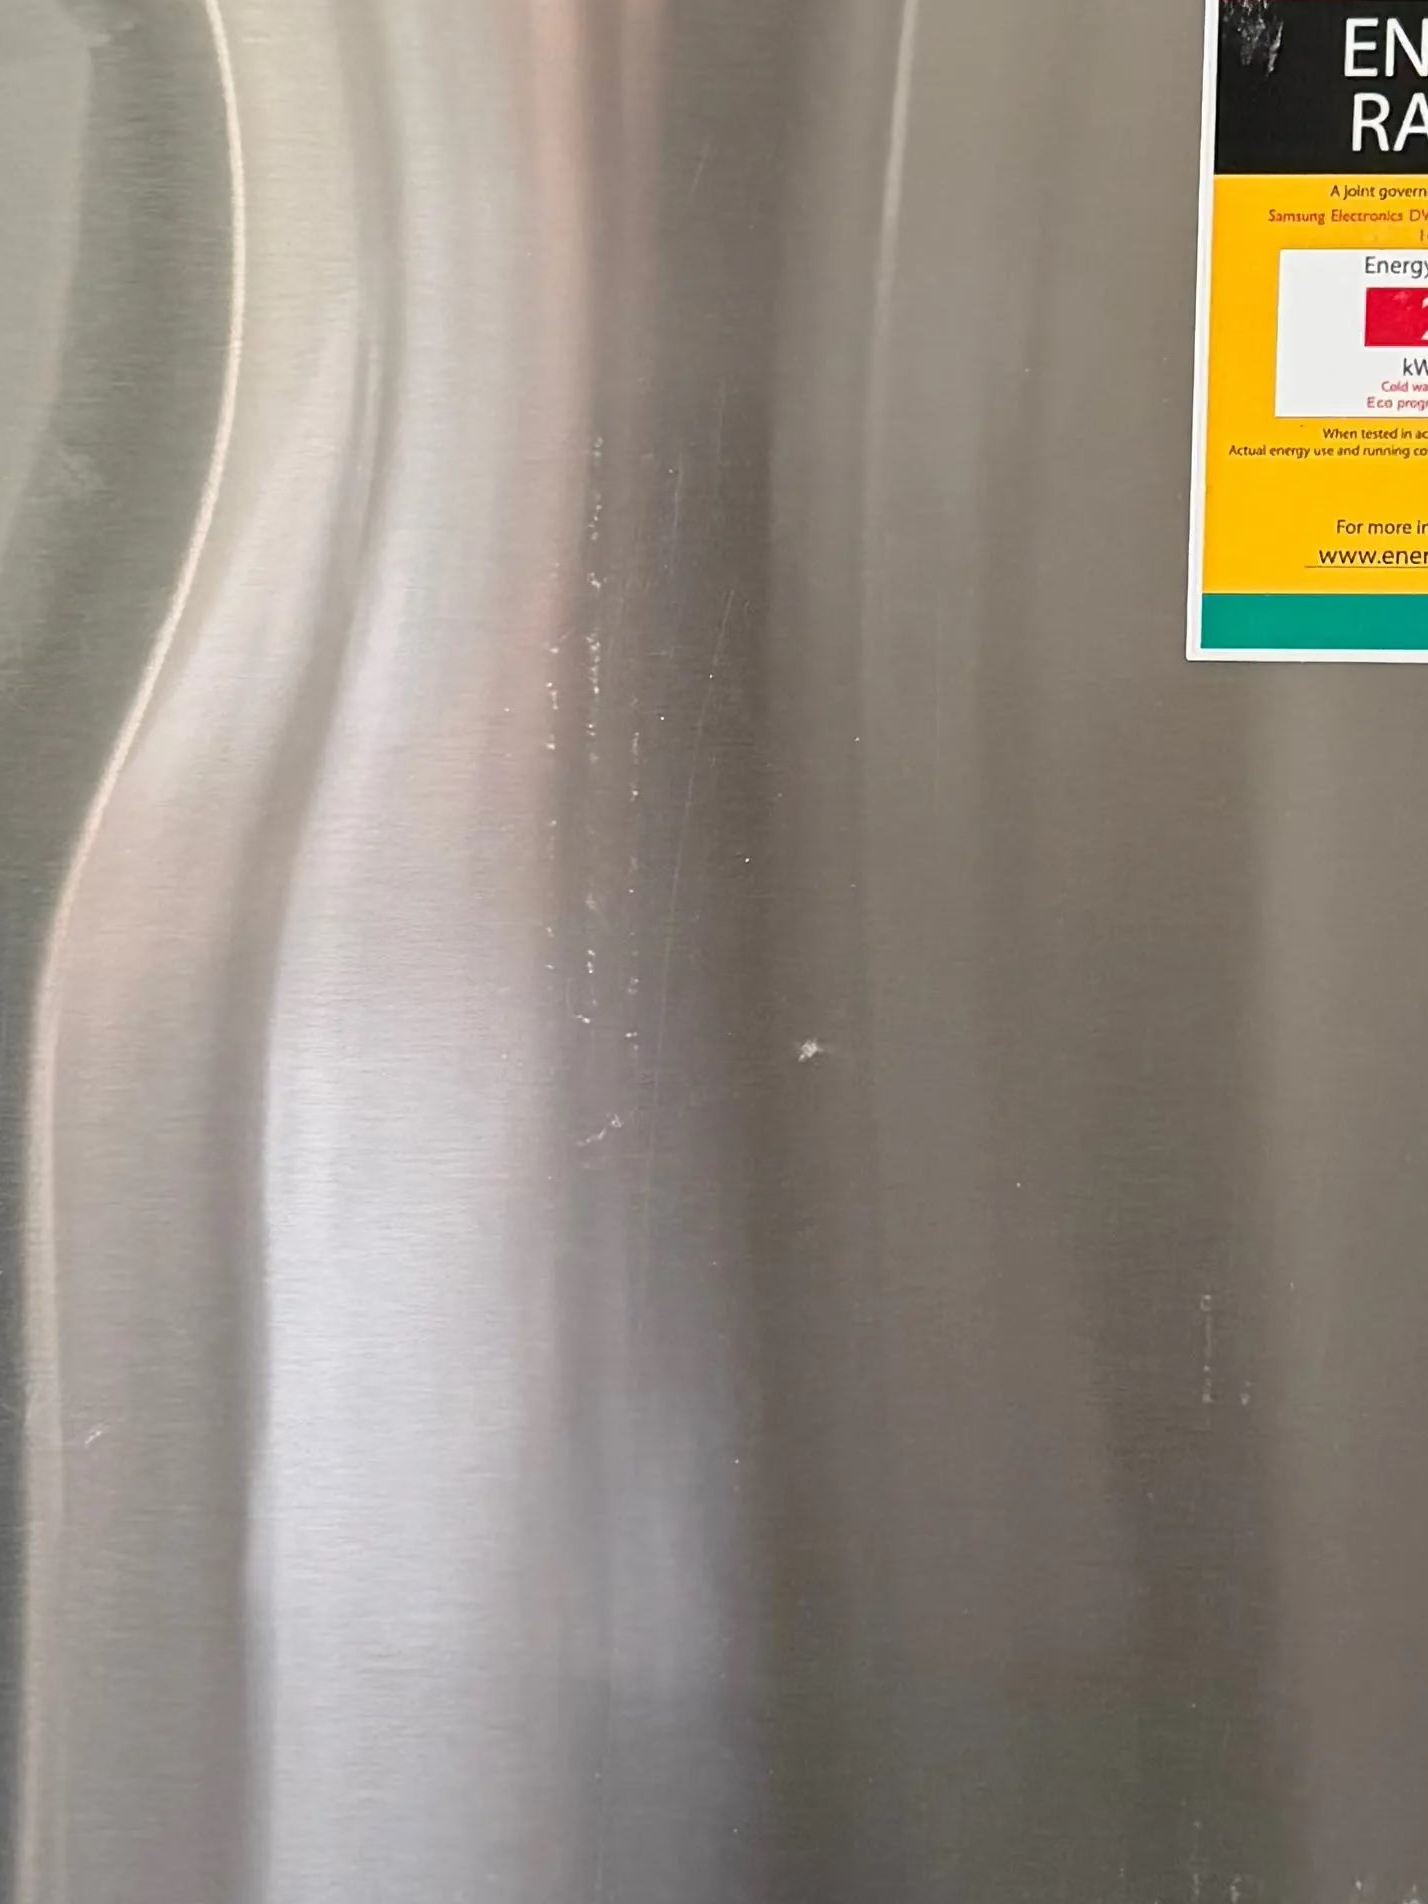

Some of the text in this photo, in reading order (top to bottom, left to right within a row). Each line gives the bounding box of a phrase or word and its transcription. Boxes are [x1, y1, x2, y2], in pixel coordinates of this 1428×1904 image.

[1330, 185, 1341, 197] A
[1343, 184, 1375, 201] joint
[1268, 209, 1325, 226] Samsung
[1330, 209, 1403, 223] Electronics
[1381, 380, 1409, 393] Cold
[1366, 396, 1393, 409] Eco
[1322, 428, 1358, 440] When
[1361, 428, 1398, 440] tested
[1400, 428, 1413, 440] in
[1228, 445, 1267, 457] Actual
[1269, 446, 1310, 459] energy
[1313, 447, 1335, 457] use
[1337, 445, 1360, 457] and
[1362, 446, 1411, 459] running
[1336, 519, 1364, 535] For
[1368, 522, 1412, 535] more
